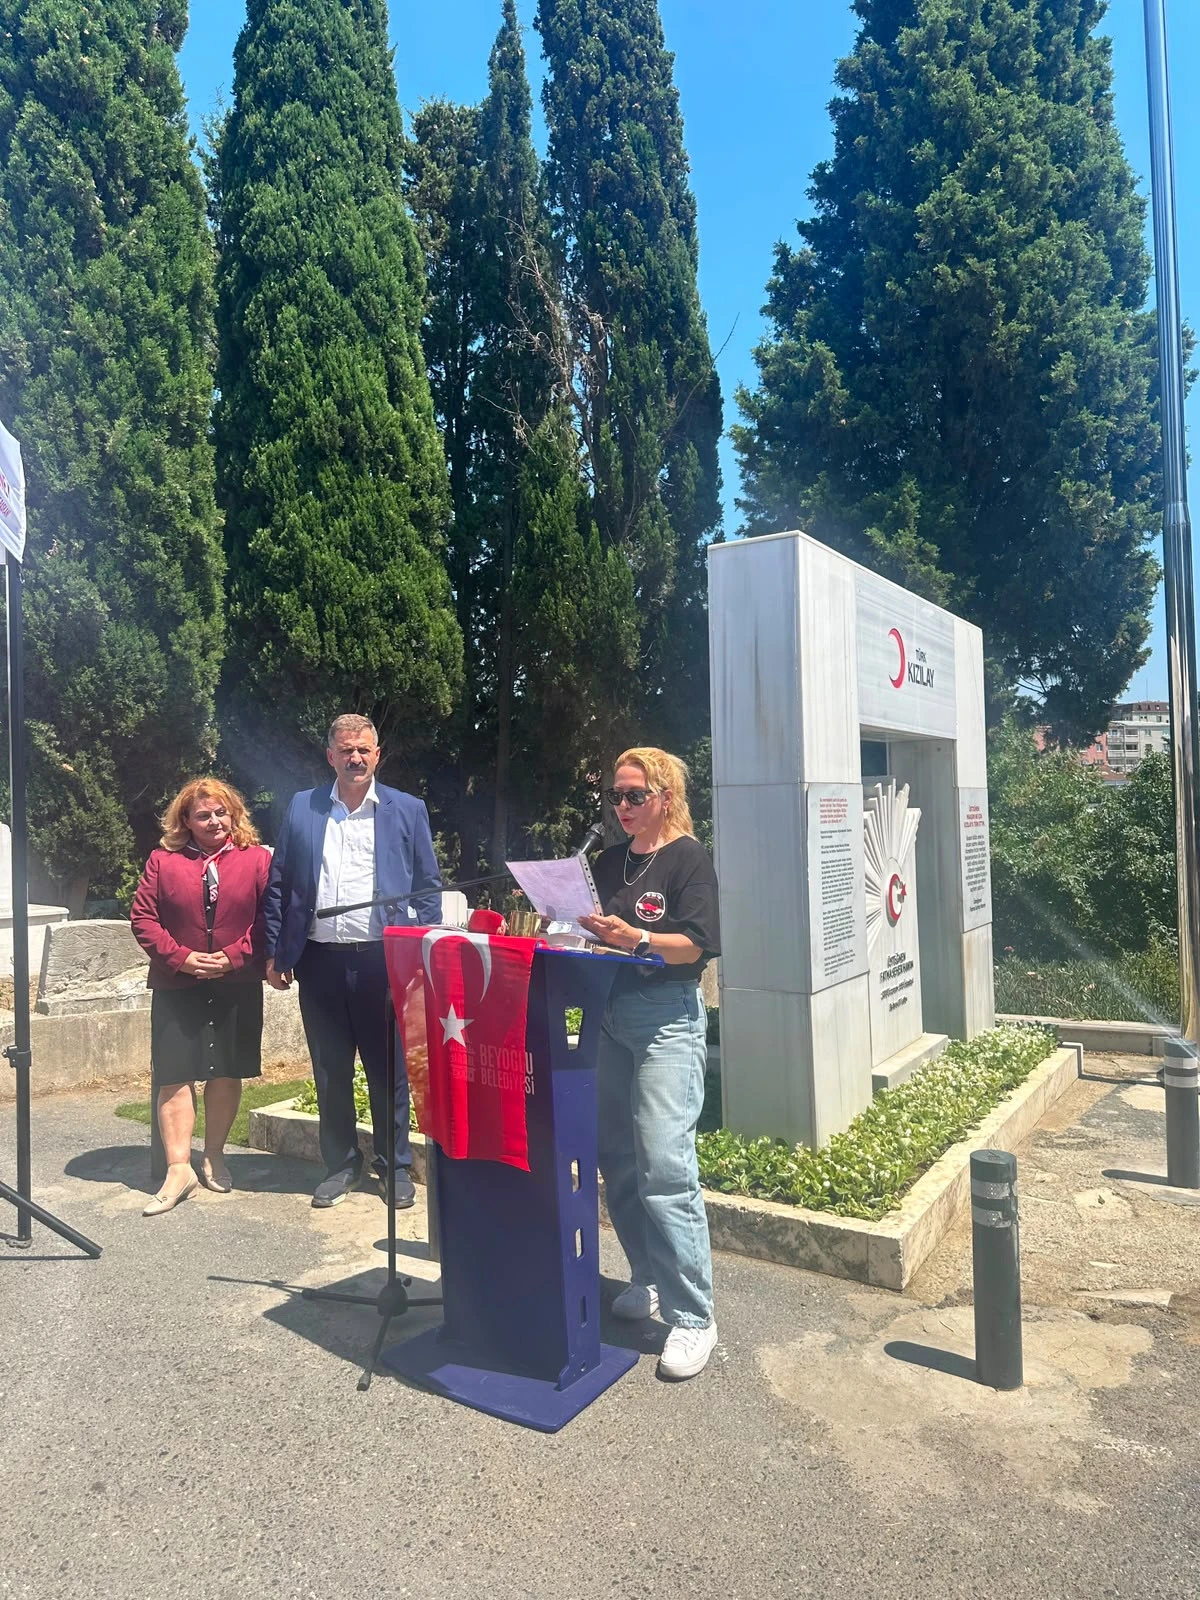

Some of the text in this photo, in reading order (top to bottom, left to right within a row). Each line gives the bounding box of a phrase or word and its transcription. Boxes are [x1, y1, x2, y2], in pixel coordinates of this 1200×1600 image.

[915, 648, 927, 663] TÜRK
[907, 661, 935, 688] KIZILAY
[479, 1043, 534, 1075] BEYOĞLU
[480, 1067, 535, 1095] BELEDİYESİ
